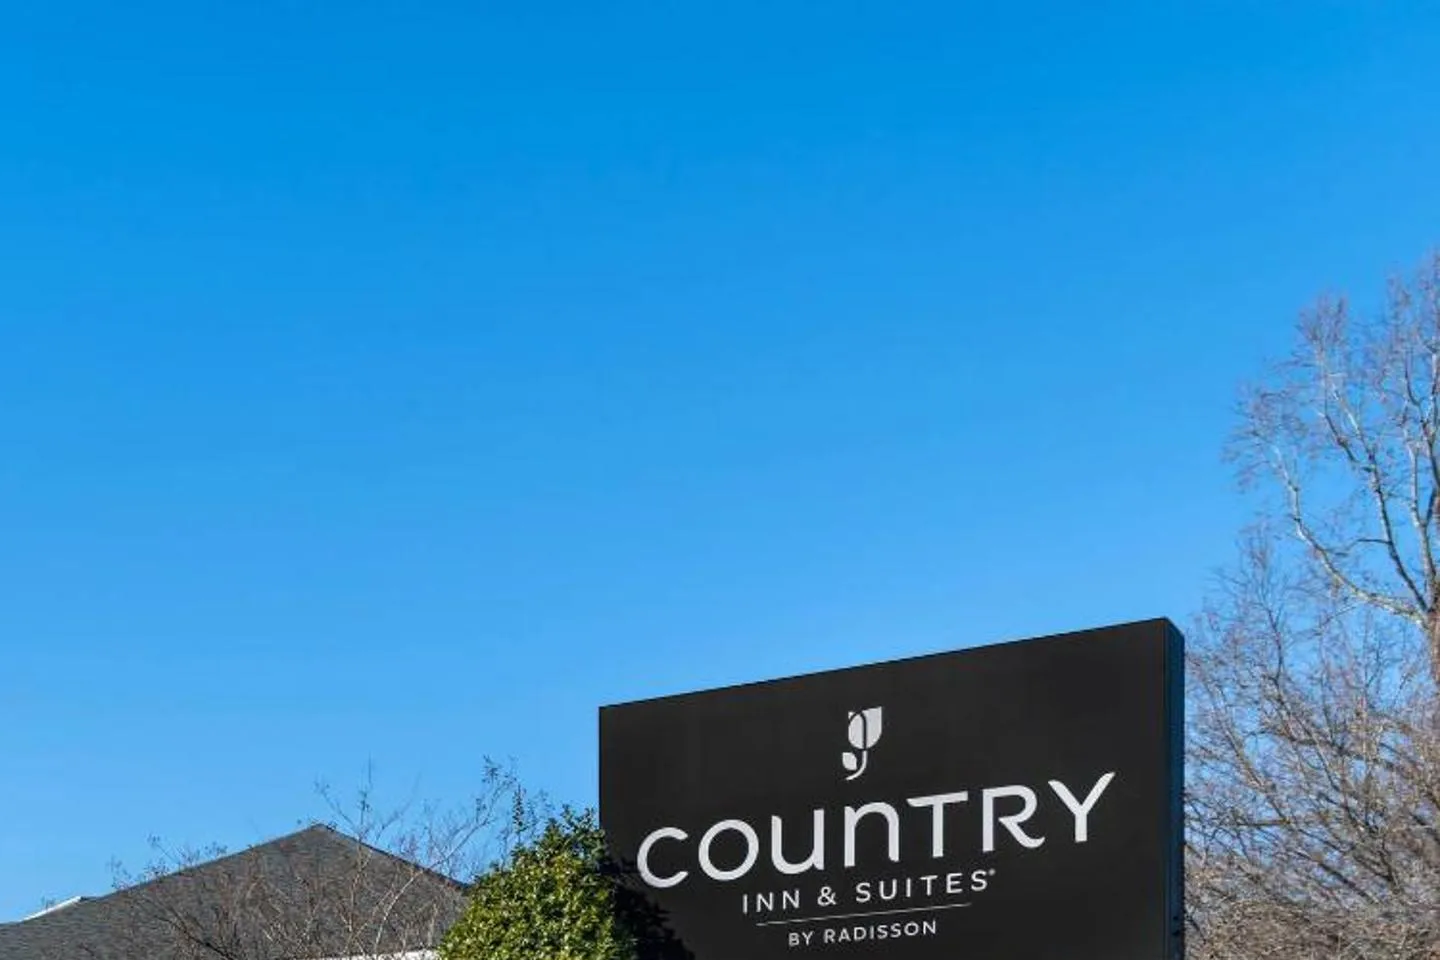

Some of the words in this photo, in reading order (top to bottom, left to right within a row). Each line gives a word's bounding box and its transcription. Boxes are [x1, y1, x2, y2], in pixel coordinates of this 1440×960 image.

[636, 771, 1116, 888] COUNTRY
[742, 889, 801, 915] INN
[816, 886, 837, 907] &
[855, 869, 989, 904] SUITES
[788, 931, 814, 947] BY
[823, 920, 937, 944] RADISSON
